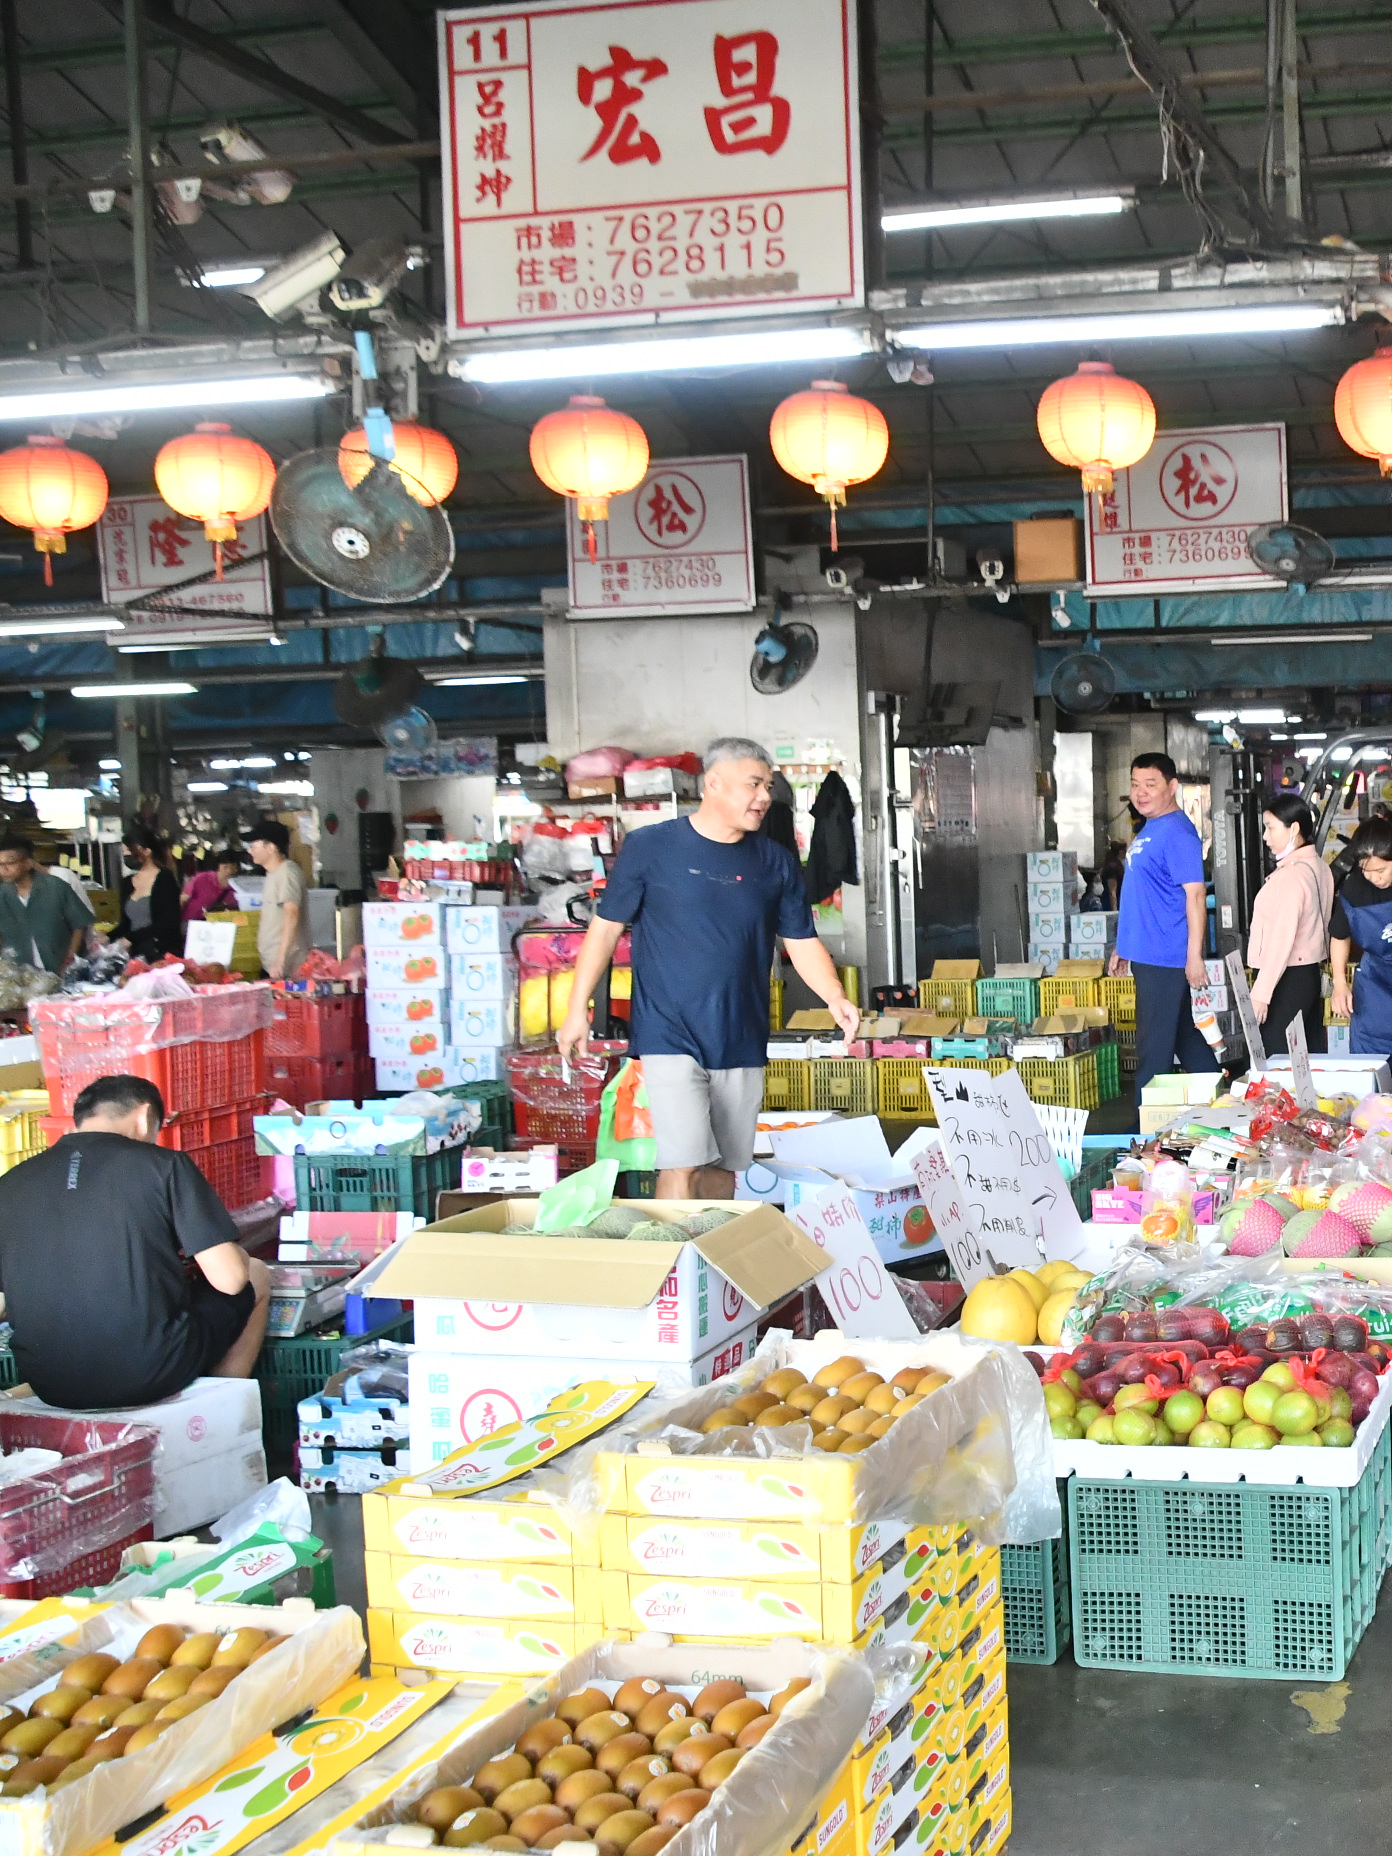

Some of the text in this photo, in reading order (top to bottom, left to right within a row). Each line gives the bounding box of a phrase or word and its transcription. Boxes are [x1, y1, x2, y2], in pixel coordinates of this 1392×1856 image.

[466, 27, 508, 63] 11
[577, 29, 791, 165] 宏昌
[1172, 451, 1228, 511] 松
[647, 482, 697, 538] 松
[1214, 810, 1227, 867] TOYOTA
[1008, 1130, 1051, 1167] 200
[951, 1231, 983, 1282] 100
[829, 1255, 883, 1321] 100
[650, 1485, 691, 1503] Zespri
[643, 1542, 684, 1559] Zespri
[645, 1599, 687, 1617] Zespri
[413, 1638, 452, 1656] Zespri
[691, 1669, 744, 1688] 64mm
[138, 1814, 224, 1856] Zesp
[818, 1806, 845, 1847] SUNGOLD
